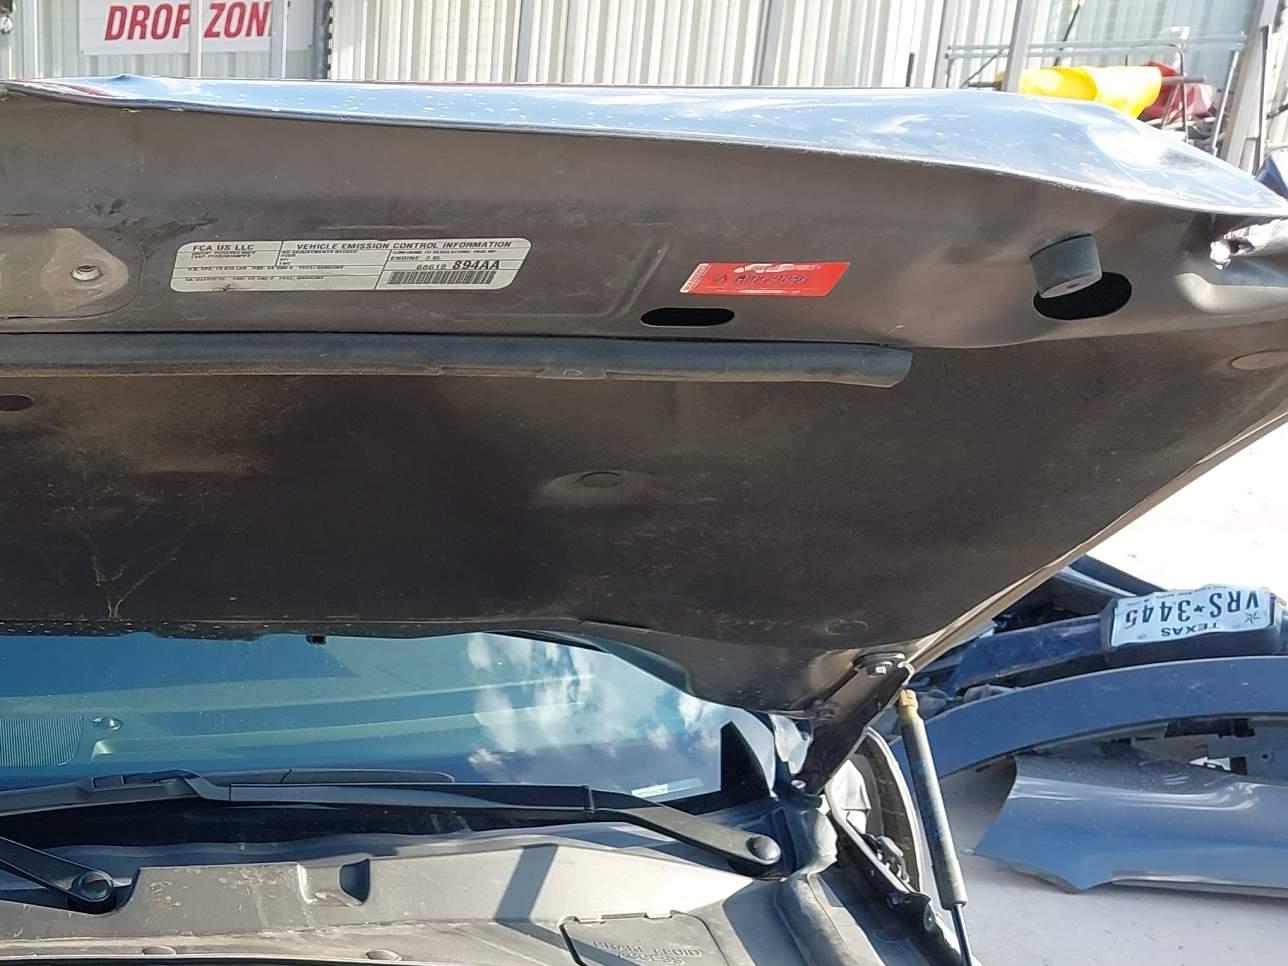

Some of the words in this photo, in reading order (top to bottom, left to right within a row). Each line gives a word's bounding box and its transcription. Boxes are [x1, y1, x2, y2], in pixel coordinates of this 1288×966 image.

[104, 3, 191, 41] DROP
[203, 1, 273, 39] ZON
[452, 260, 500, 270] 894AA
[1209, 590, 1259, 618] VRS
[1161, 621, 1219, 637] TEXAS
